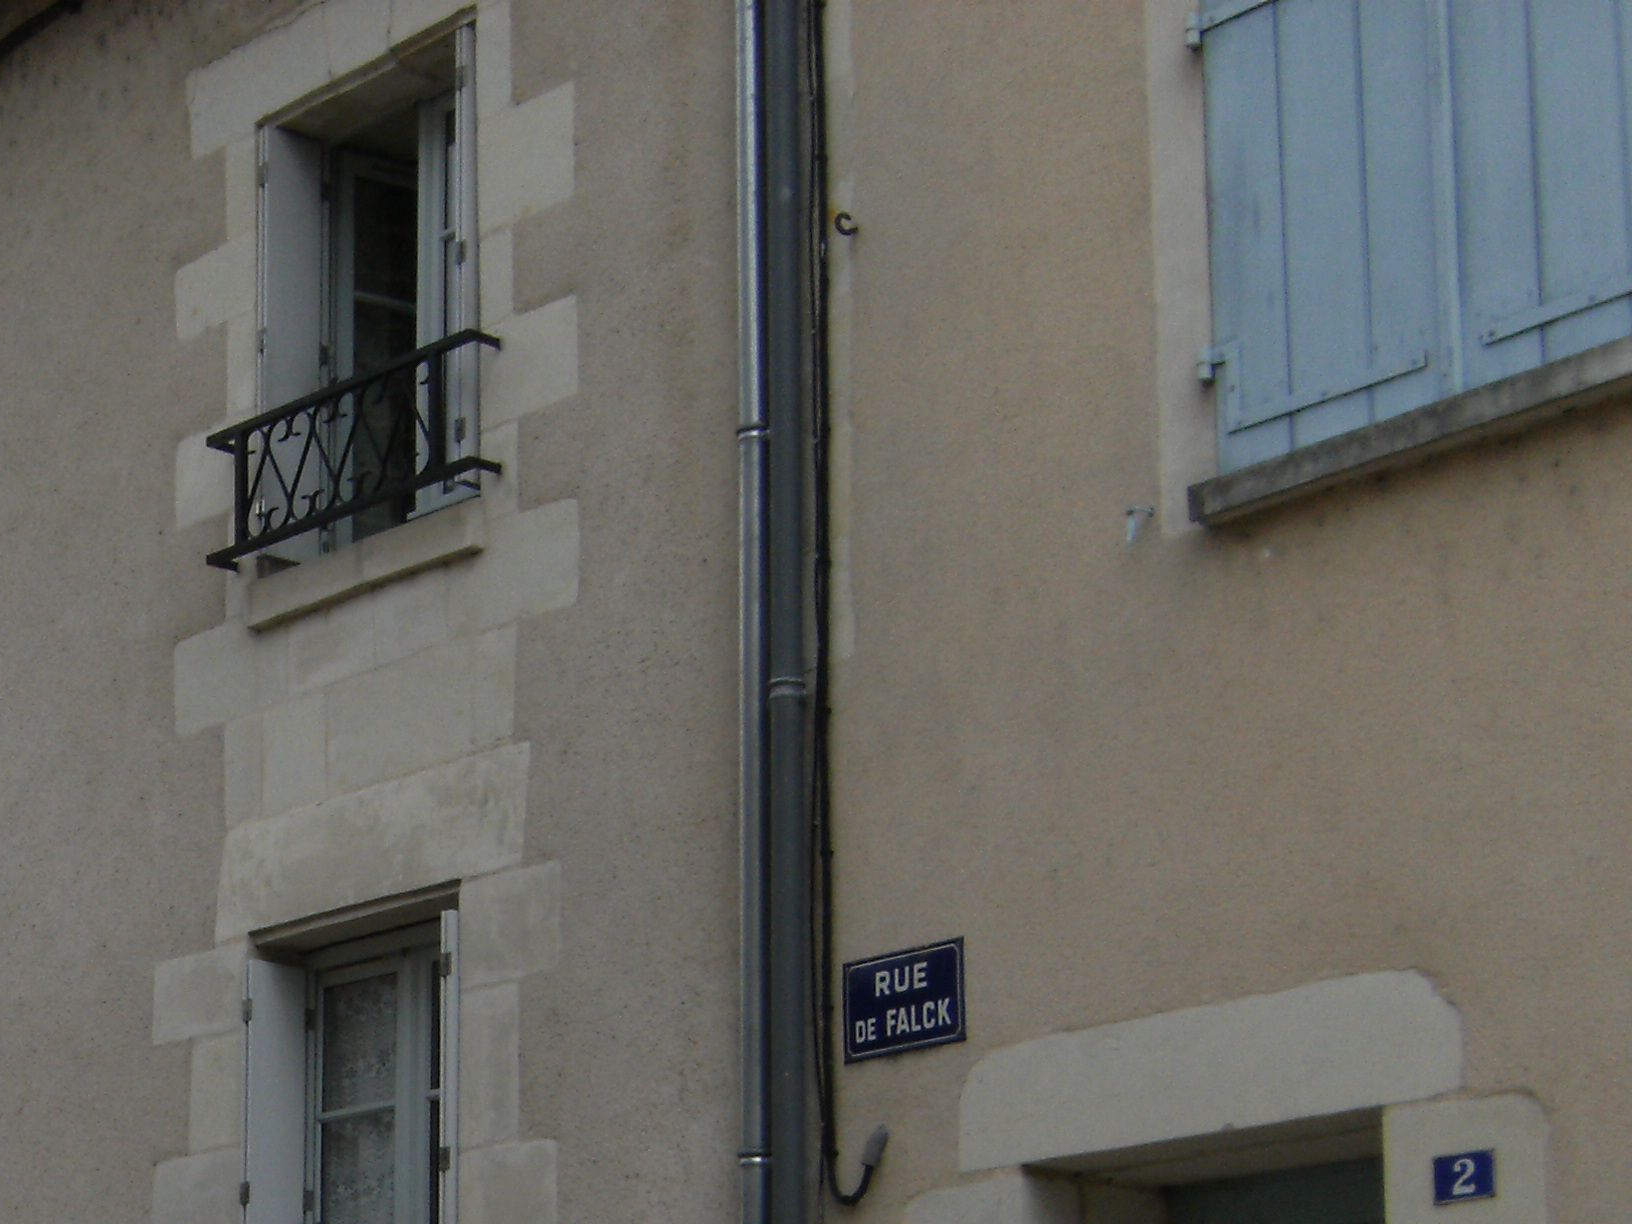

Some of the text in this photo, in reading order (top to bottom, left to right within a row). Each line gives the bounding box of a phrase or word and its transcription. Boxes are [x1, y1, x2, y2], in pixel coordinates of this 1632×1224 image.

[874, 961, 928, 997] RUE
[855, 997, 952, 1044] DE FALCK
[1452, 1158, 1475, 1196] 2
